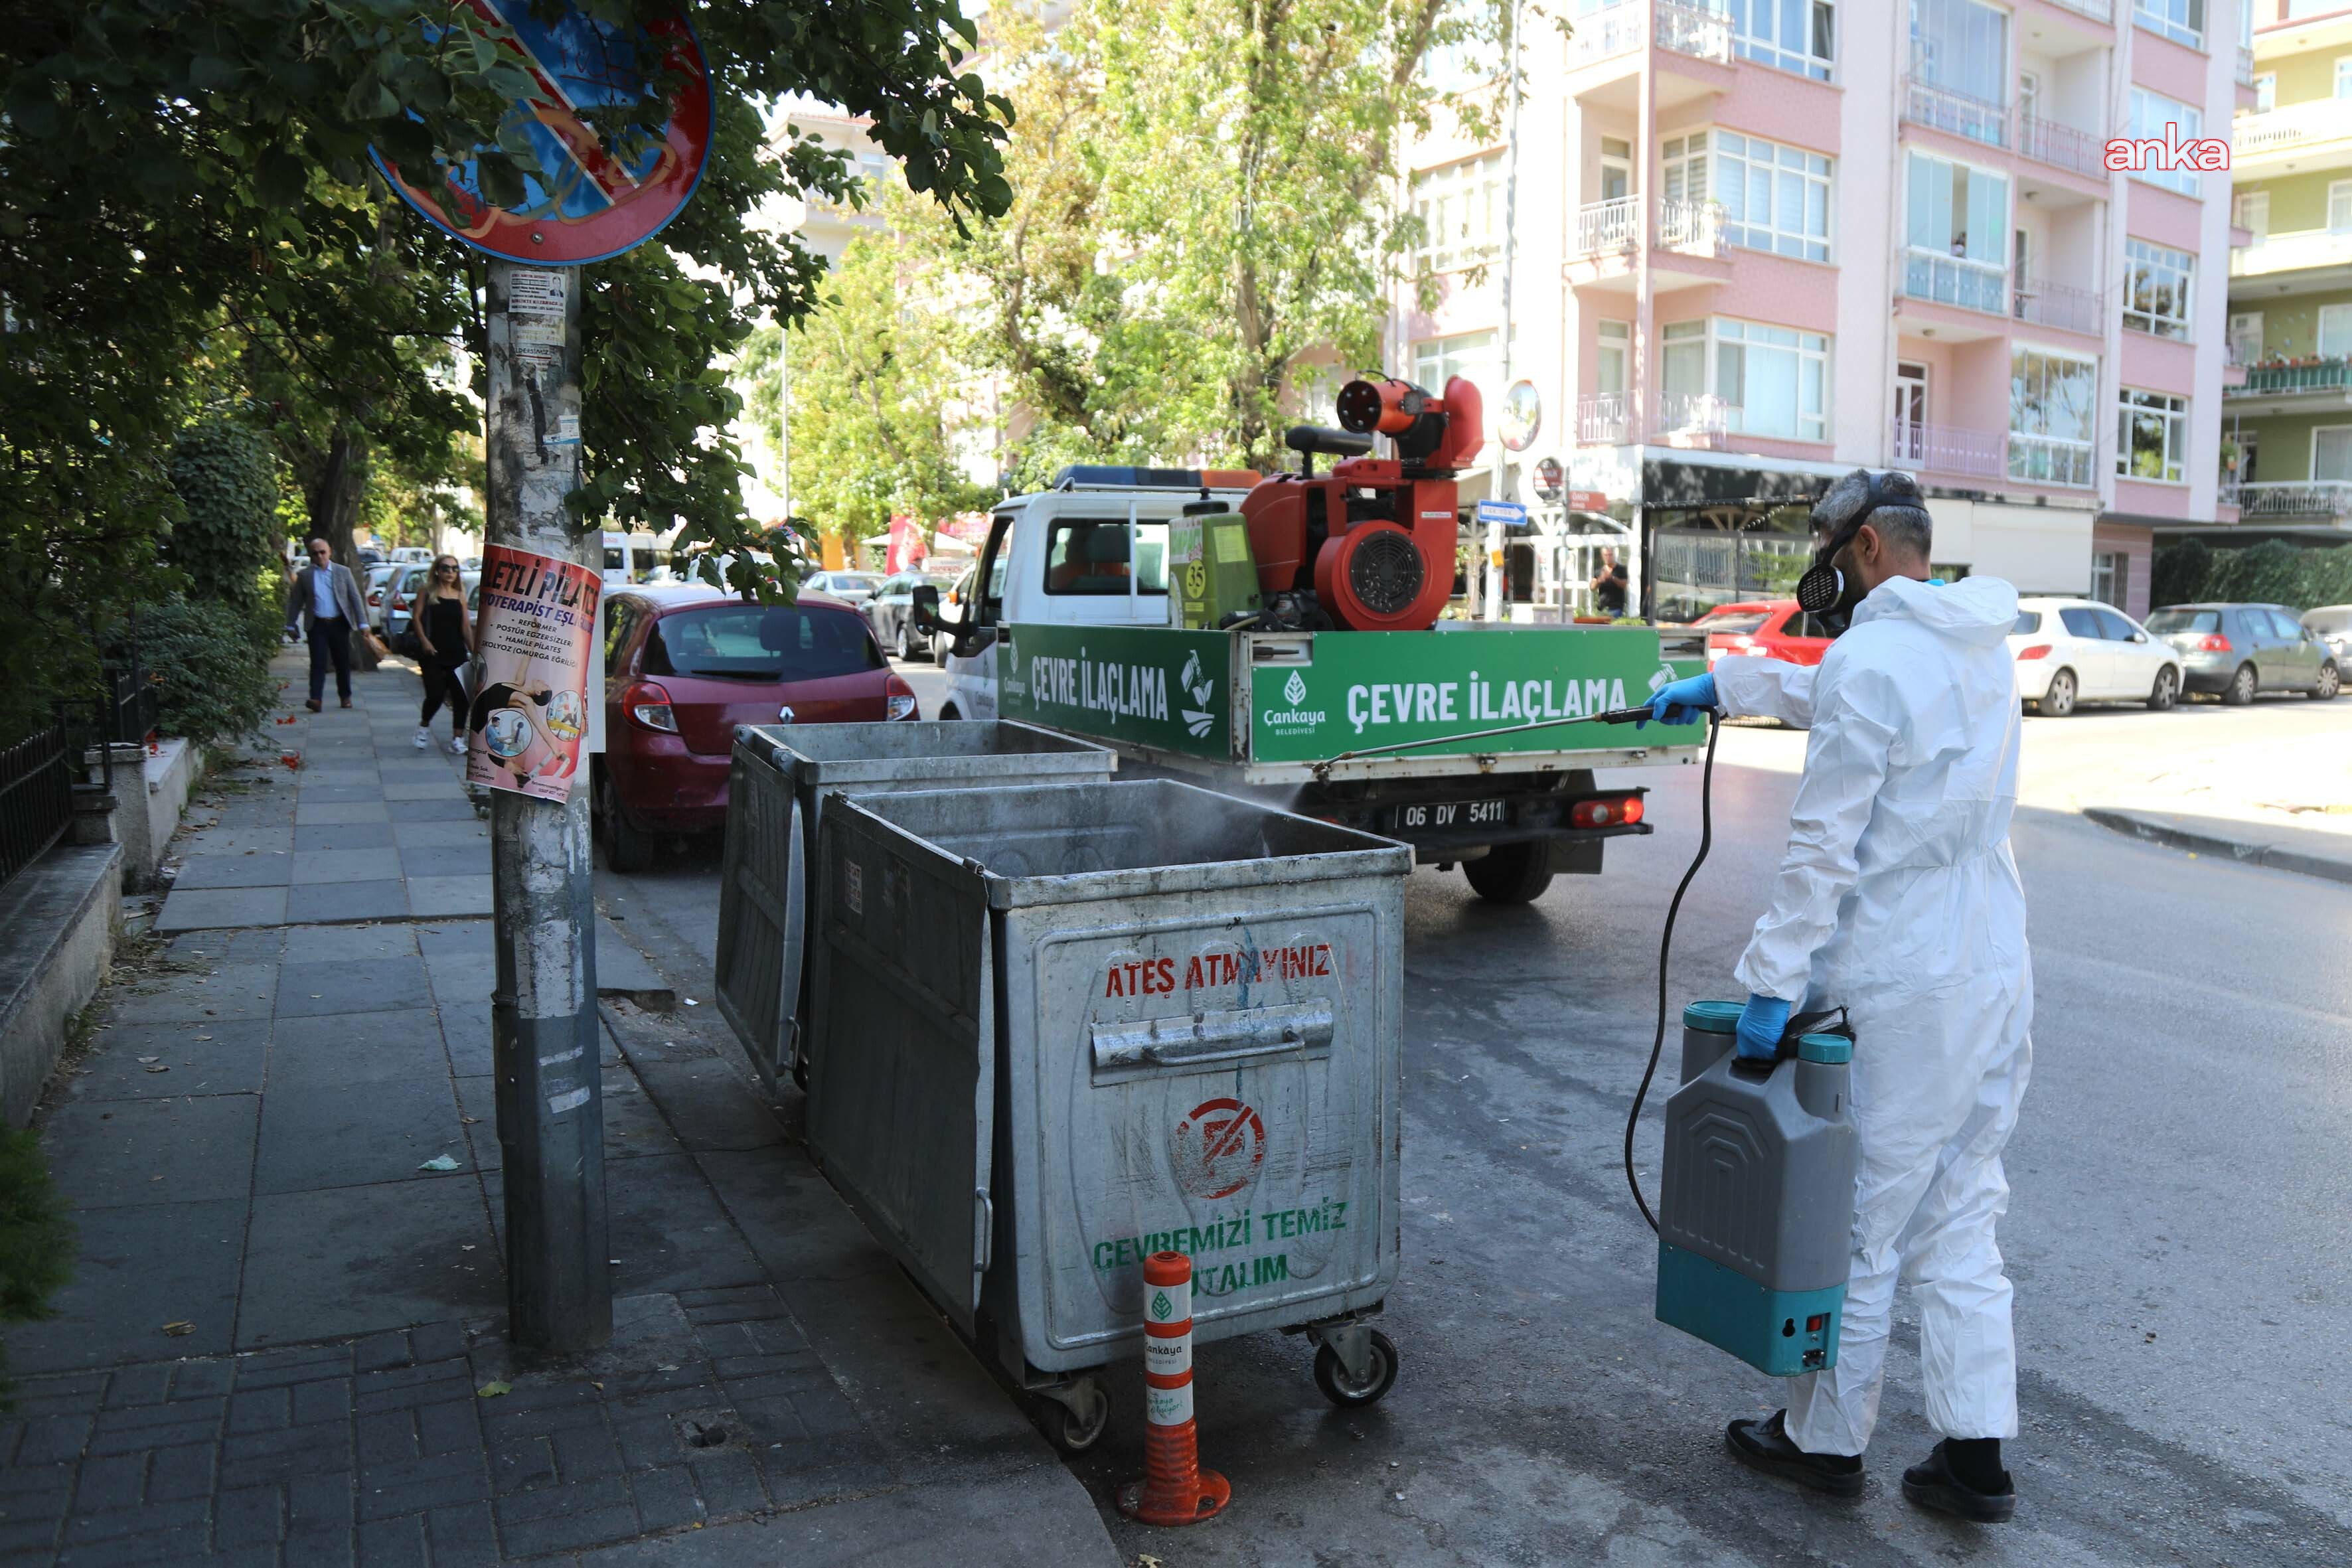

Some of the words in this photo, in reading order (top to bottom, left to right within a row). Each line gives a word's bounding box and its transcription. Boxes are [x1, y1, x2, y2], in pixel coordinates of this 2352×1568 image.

[1188, 566, 1203, 587] 35
[497, 624, 525, 635] POSTÜR
[518, 619, 557, 633] REFORMER
[505, 635, 532, 647] HAMİLE
[534, 641, 562, 654] PİLATES
[1032, 655, 1077, 711] ÇEVRE
[1081, 646, 1168, 725] İLAÇLAMA
[1348, 682, 1458, 734] ÇEVRE
[1469, 670, 1627, 725] İLAÇLAMA
[1263, 708, 1326, 726] Çankaya
[1275, 726, 1315, 736] BELEDİYESİ
[1406, 807, 1427, 826] 06
[1436, 805, 1457, 824] DV
[1469, 801, 1502, 823] 5411
[1105, 957, 1175, 998] ATEŞ
[1261, 1197, 1350, 1241] TEMİZ
